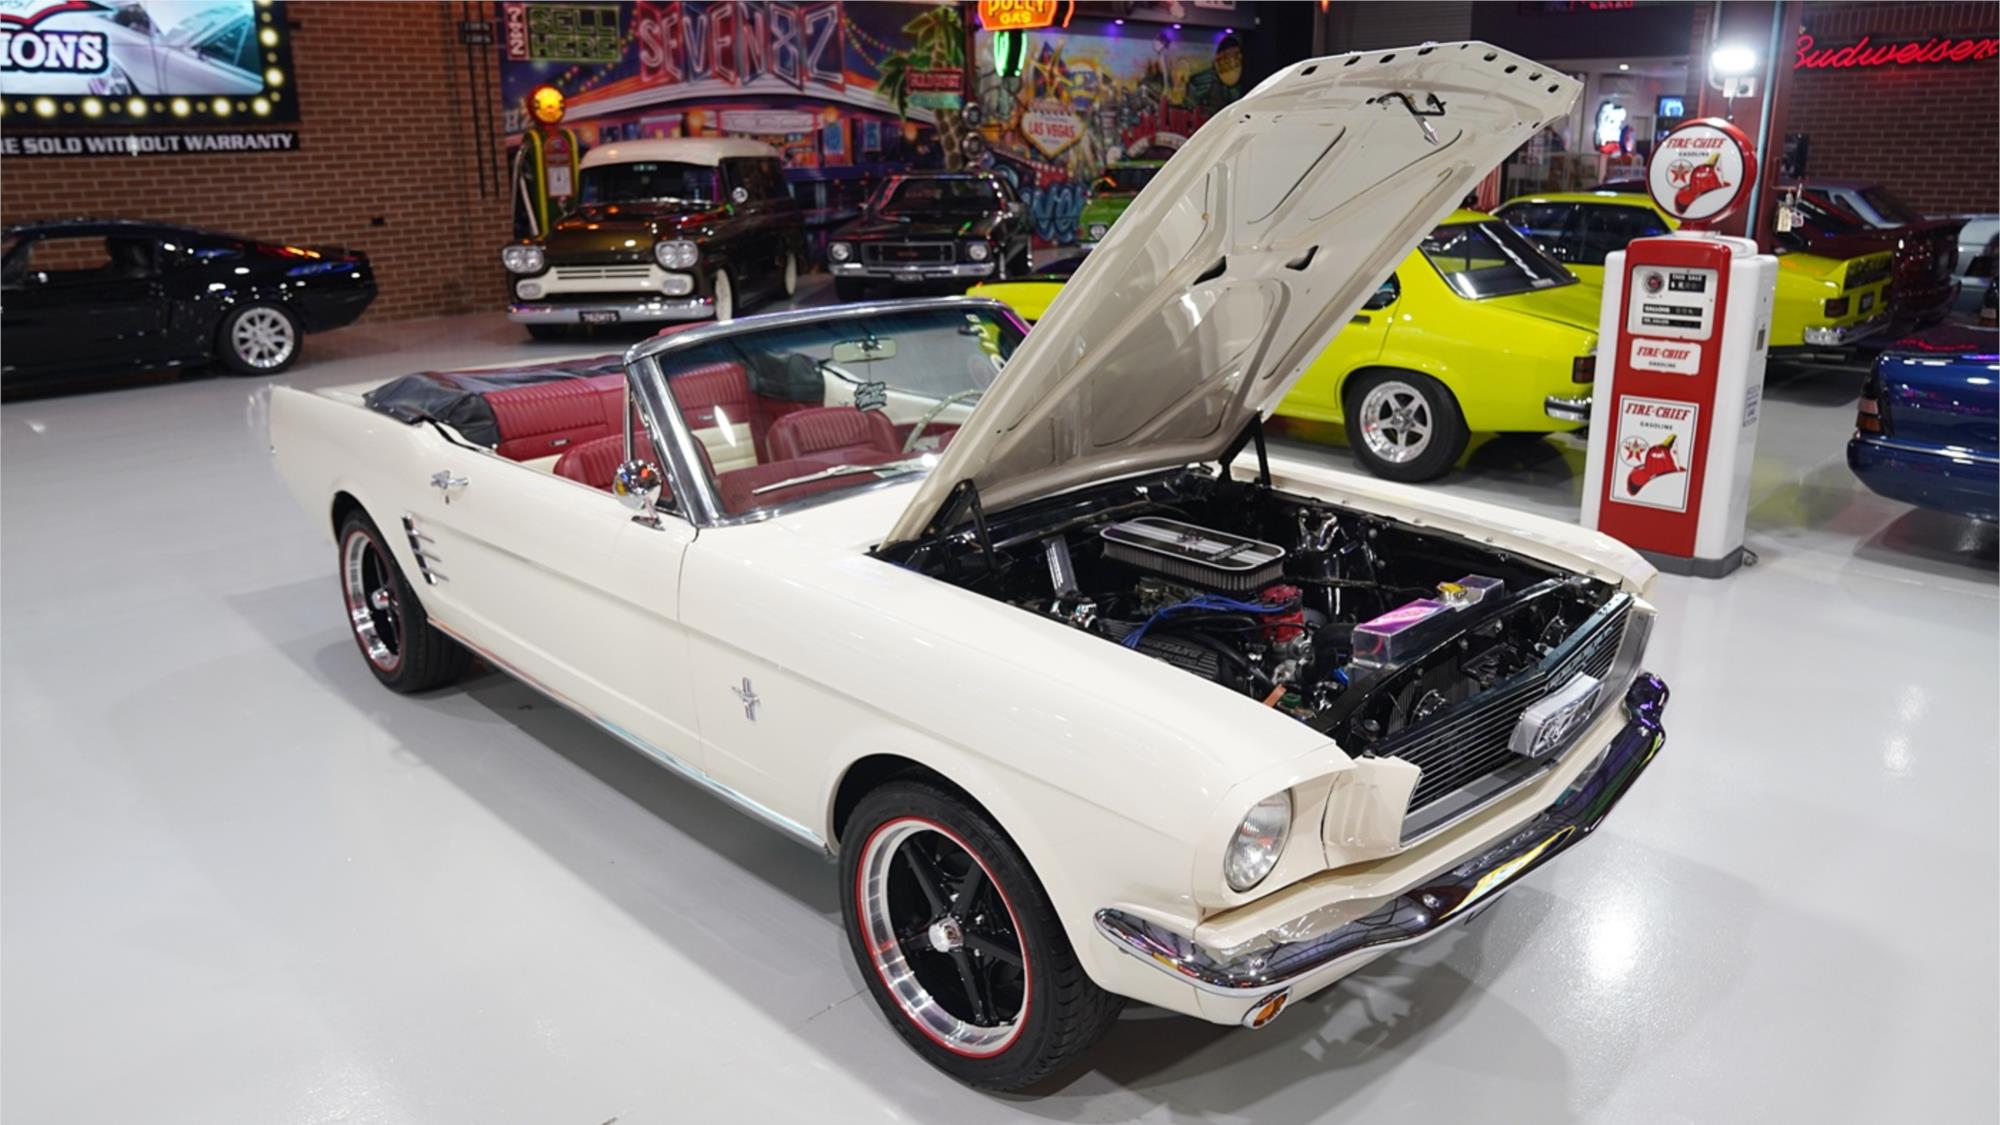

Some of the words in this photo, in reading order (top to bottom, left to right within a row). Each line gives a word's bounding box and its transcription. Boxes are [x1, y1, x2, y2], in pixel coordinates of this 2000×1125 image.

[529, 8, 616, 34] SELL
[1000, 12, 1031, 24] GAS
[1, 31, 104, 69] IONS
[530, 34, 617, 57] HERE
[1028, 121, 1044, 136] LAS
[1045, 123, 1075, 138] VEGAS
[23, 137, 82, 154] SOLD
[184, 134, 293, 151] WARRANTY
[1667, 137, 1727, 149] FIRE-CHIEF
[1637, 346, 1691, 361] FIRE-CHIEF
[1625, 402, 1692, 421] FIRE-CHIEF
[1640, 421, 1673, 431] GASOLINE
